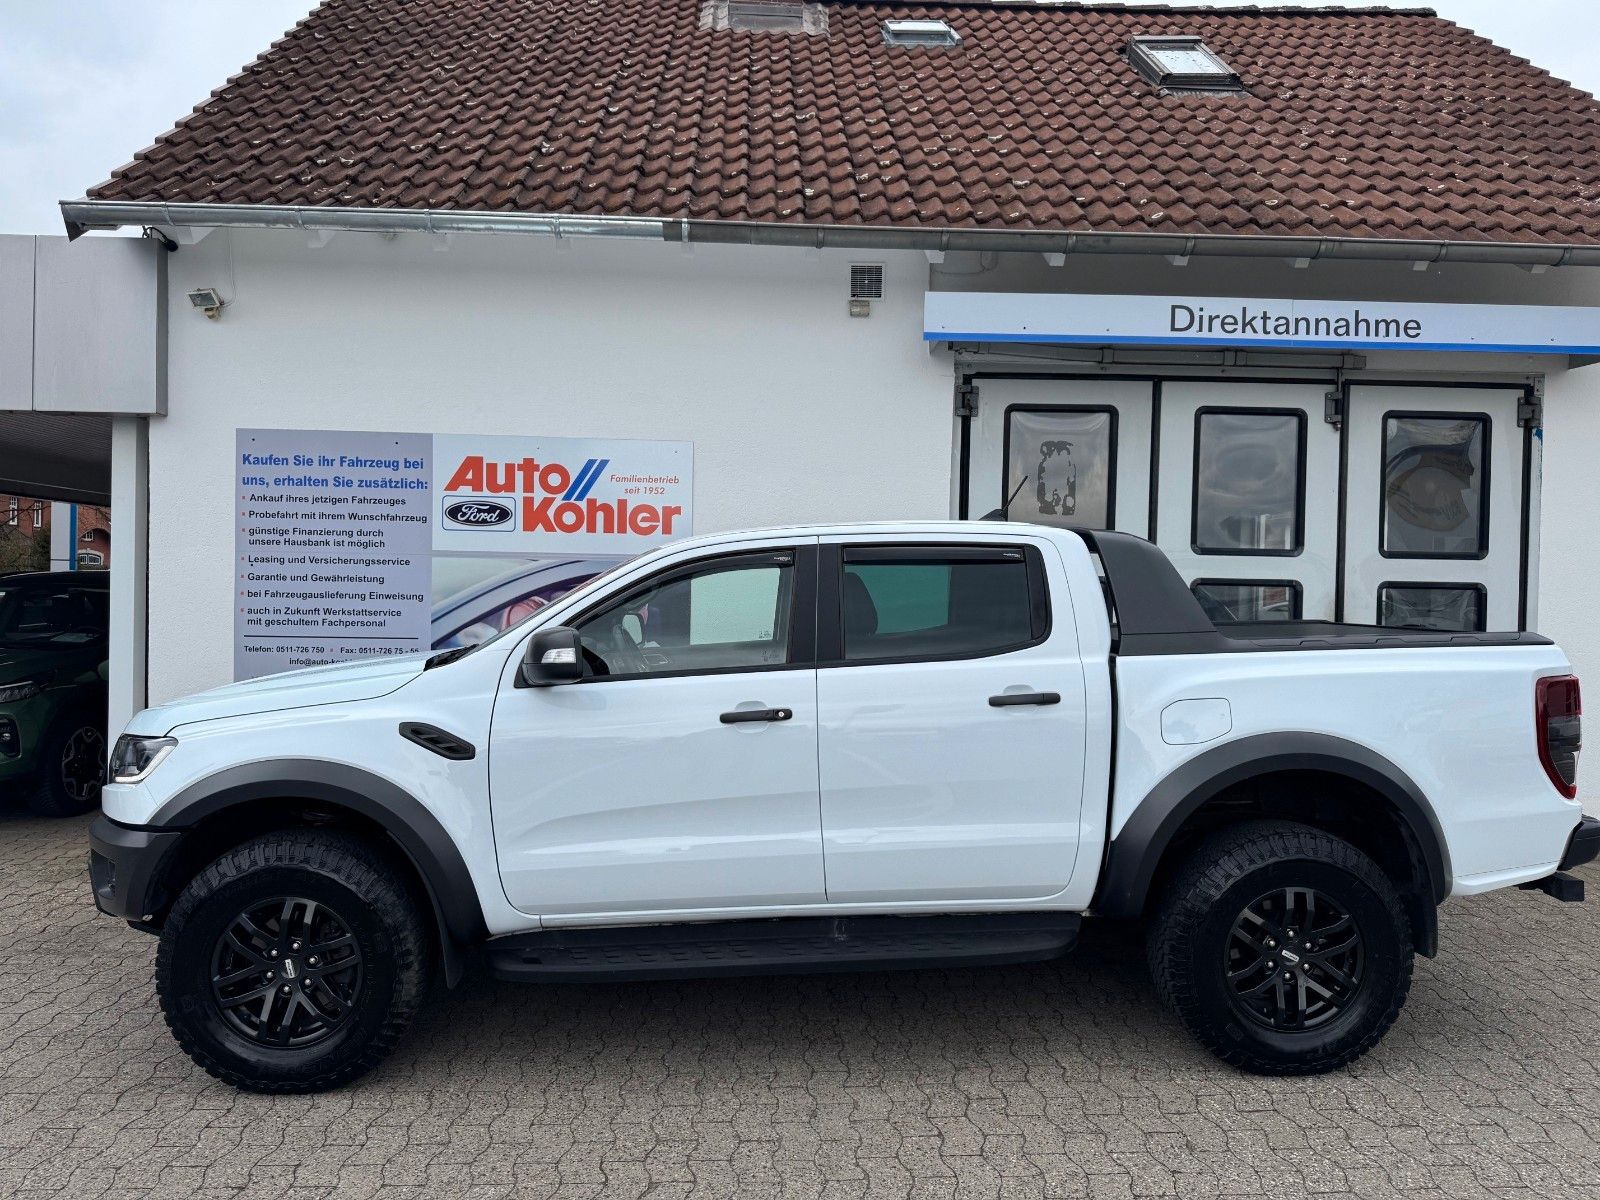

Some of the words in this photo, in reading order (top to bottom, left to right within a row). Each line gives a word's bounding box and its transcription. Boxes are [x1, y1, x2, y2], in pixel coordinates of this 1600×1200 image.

[1169, 304, 1422, 338] Direktannahme
[242, 454, 289, 466] Kaufen
[293, 455, 314, 466] Sie
[318, 456, 335, 467] ihr
[340, 456, 399, 471] Fahrzeug
[404, 458, 424, 469] bei
[444, 456, 570, 495] Auto
[610, 474, 679, 484] Familienbetrieb
[242, 477, 269, 487] uns,
[274, 476, 328, 488] erhalten
[333, 477, 354, 488] Sie
[357, 477, 428, 489] zusätzlich:
[643, 487, 665, 495] 1952
[249, 494, 283, 502] Ankauf
[286, 495, 309, 503] ihres
[312, 495, 348, 505] jetzigen
[351, 496, 406, 506] Fahrzeuges
[248, 511, 299, 519] Probefahrt
[301, 512, 316, 520] mit
[319, 512, 346, 520] ihrem
[348, 512, 428, 523] Wunschfahrzeug
[457, 503, 499, 522] Ford
[248, 527, 290, 536] günstige
[292, 528, 354, 538] Finanzierung
[356, 529, 384, 537] durch
[284, 539, 331, 547] Hausbank
[333, 539, 345, 547] ist
[347, 539, 385, 548] möglich
[248, 555, 285, 565] Leasing
[288, 556, 306, 564] und
[308, 556, 410, 567] Versicherungsservice
[248, 573, 287, 581] Garantie
[290, 574, 308, 582] und
[310, 574, 385, 584] Gewährleistung
[247, 590, 262, 598] bei
[264, 590, 366, 601] Fahrzeugauslieferung
[369, 592, 424, 602] Einweisung
[247, 607, 270, 615] auch
[284, 607, 320, 616] Zukunft
[323, 608, 402, 617] Werkstattservice
[247, 618, 263, 626] mit
[265, 619, 319, 628] geschultem
[322, 619, 386, 628] Fachpersonal
[244, 645, 274, 653] Telefon:
[276, 645, 310, 653] 0511-726
